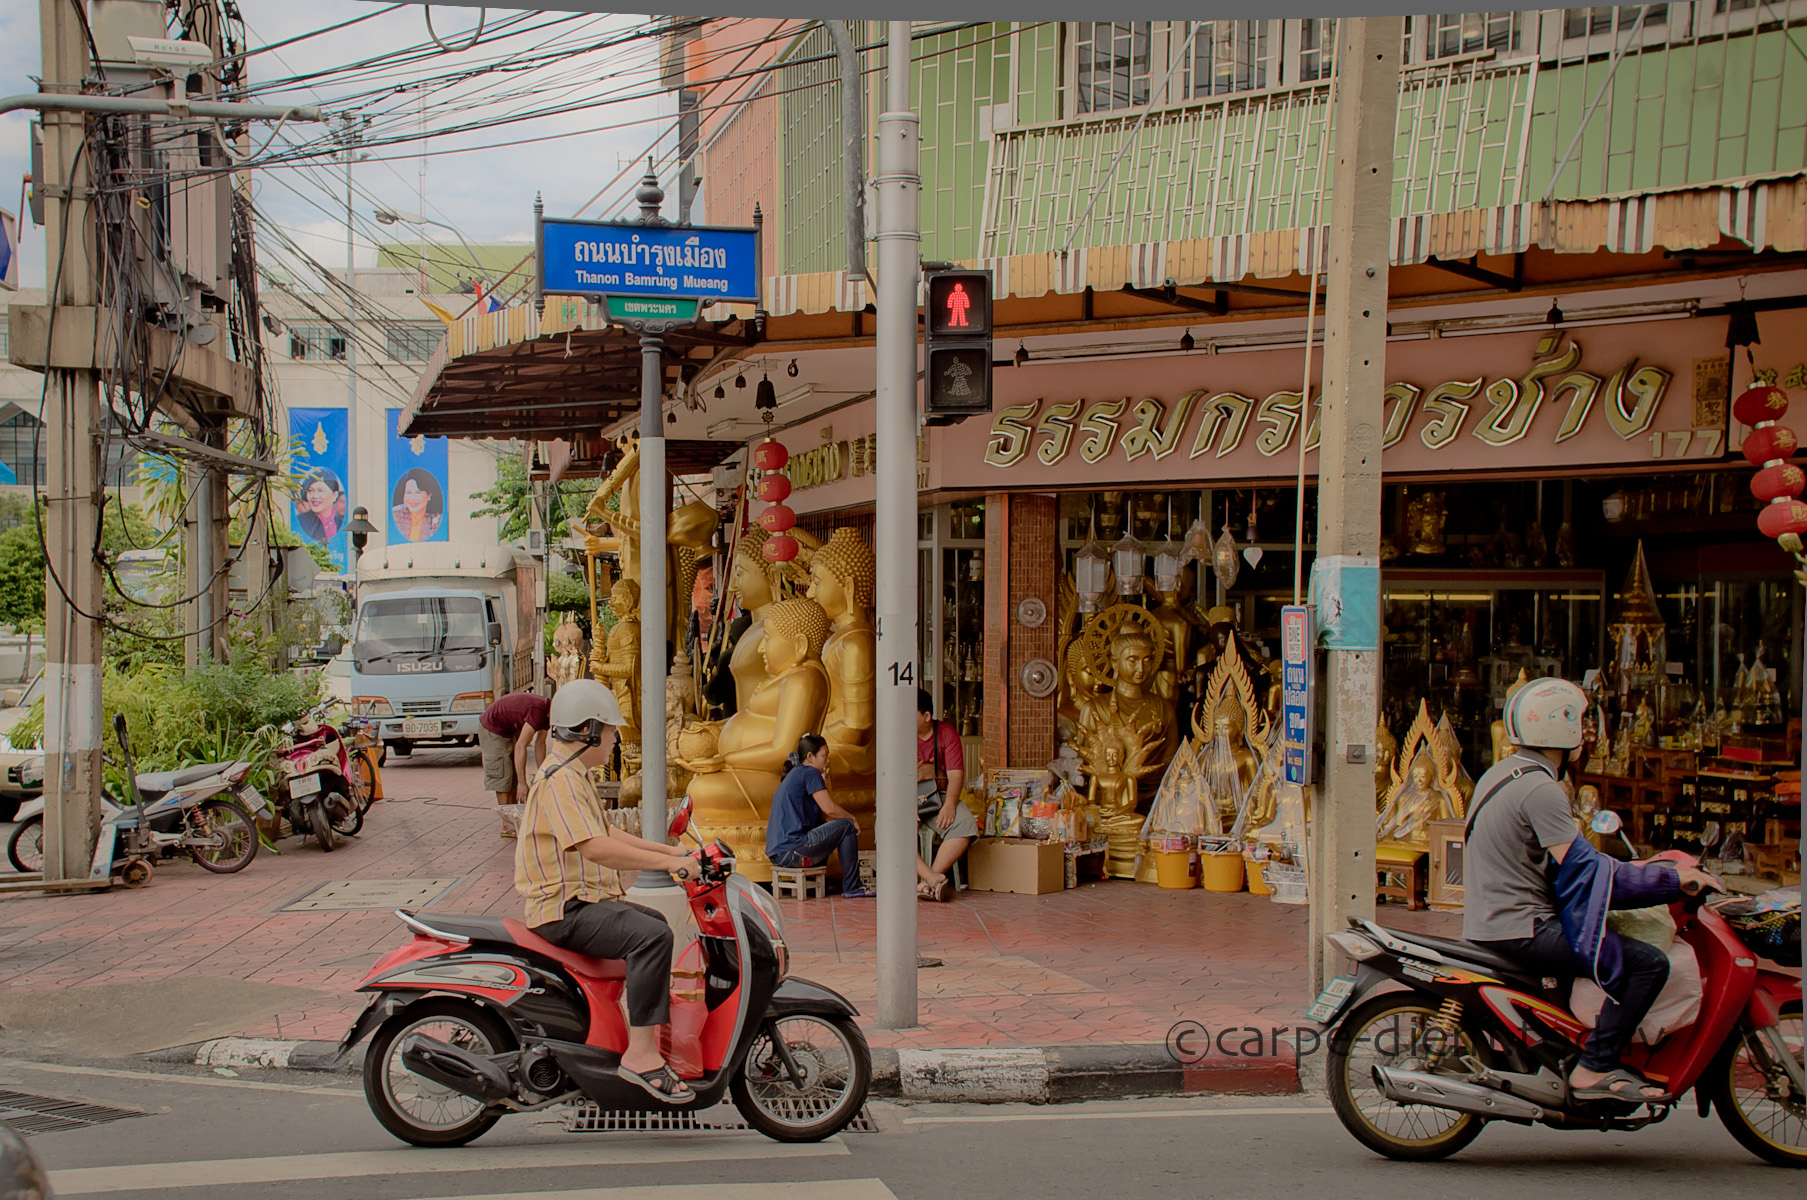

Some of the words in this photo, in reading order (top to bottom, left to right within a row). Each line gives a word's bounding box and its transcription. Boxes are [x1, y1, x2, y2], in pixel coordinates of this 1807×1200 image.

[574, 234, 727, 275] ถนนบำรุงเมือง
[575, 270, 620, 285] Thanon
[625, 272, 678, 291] Bamrung
[683, 275, 729, 292] Mueang
[624, 302, 677, 314] เขตพระนคร
[1648, 429, 1724, 459] 177
[396, 661, 443, 673] ISUZU
[887, 661, 914, 686] 14
[405, 722, 440, 734] 80-7035
